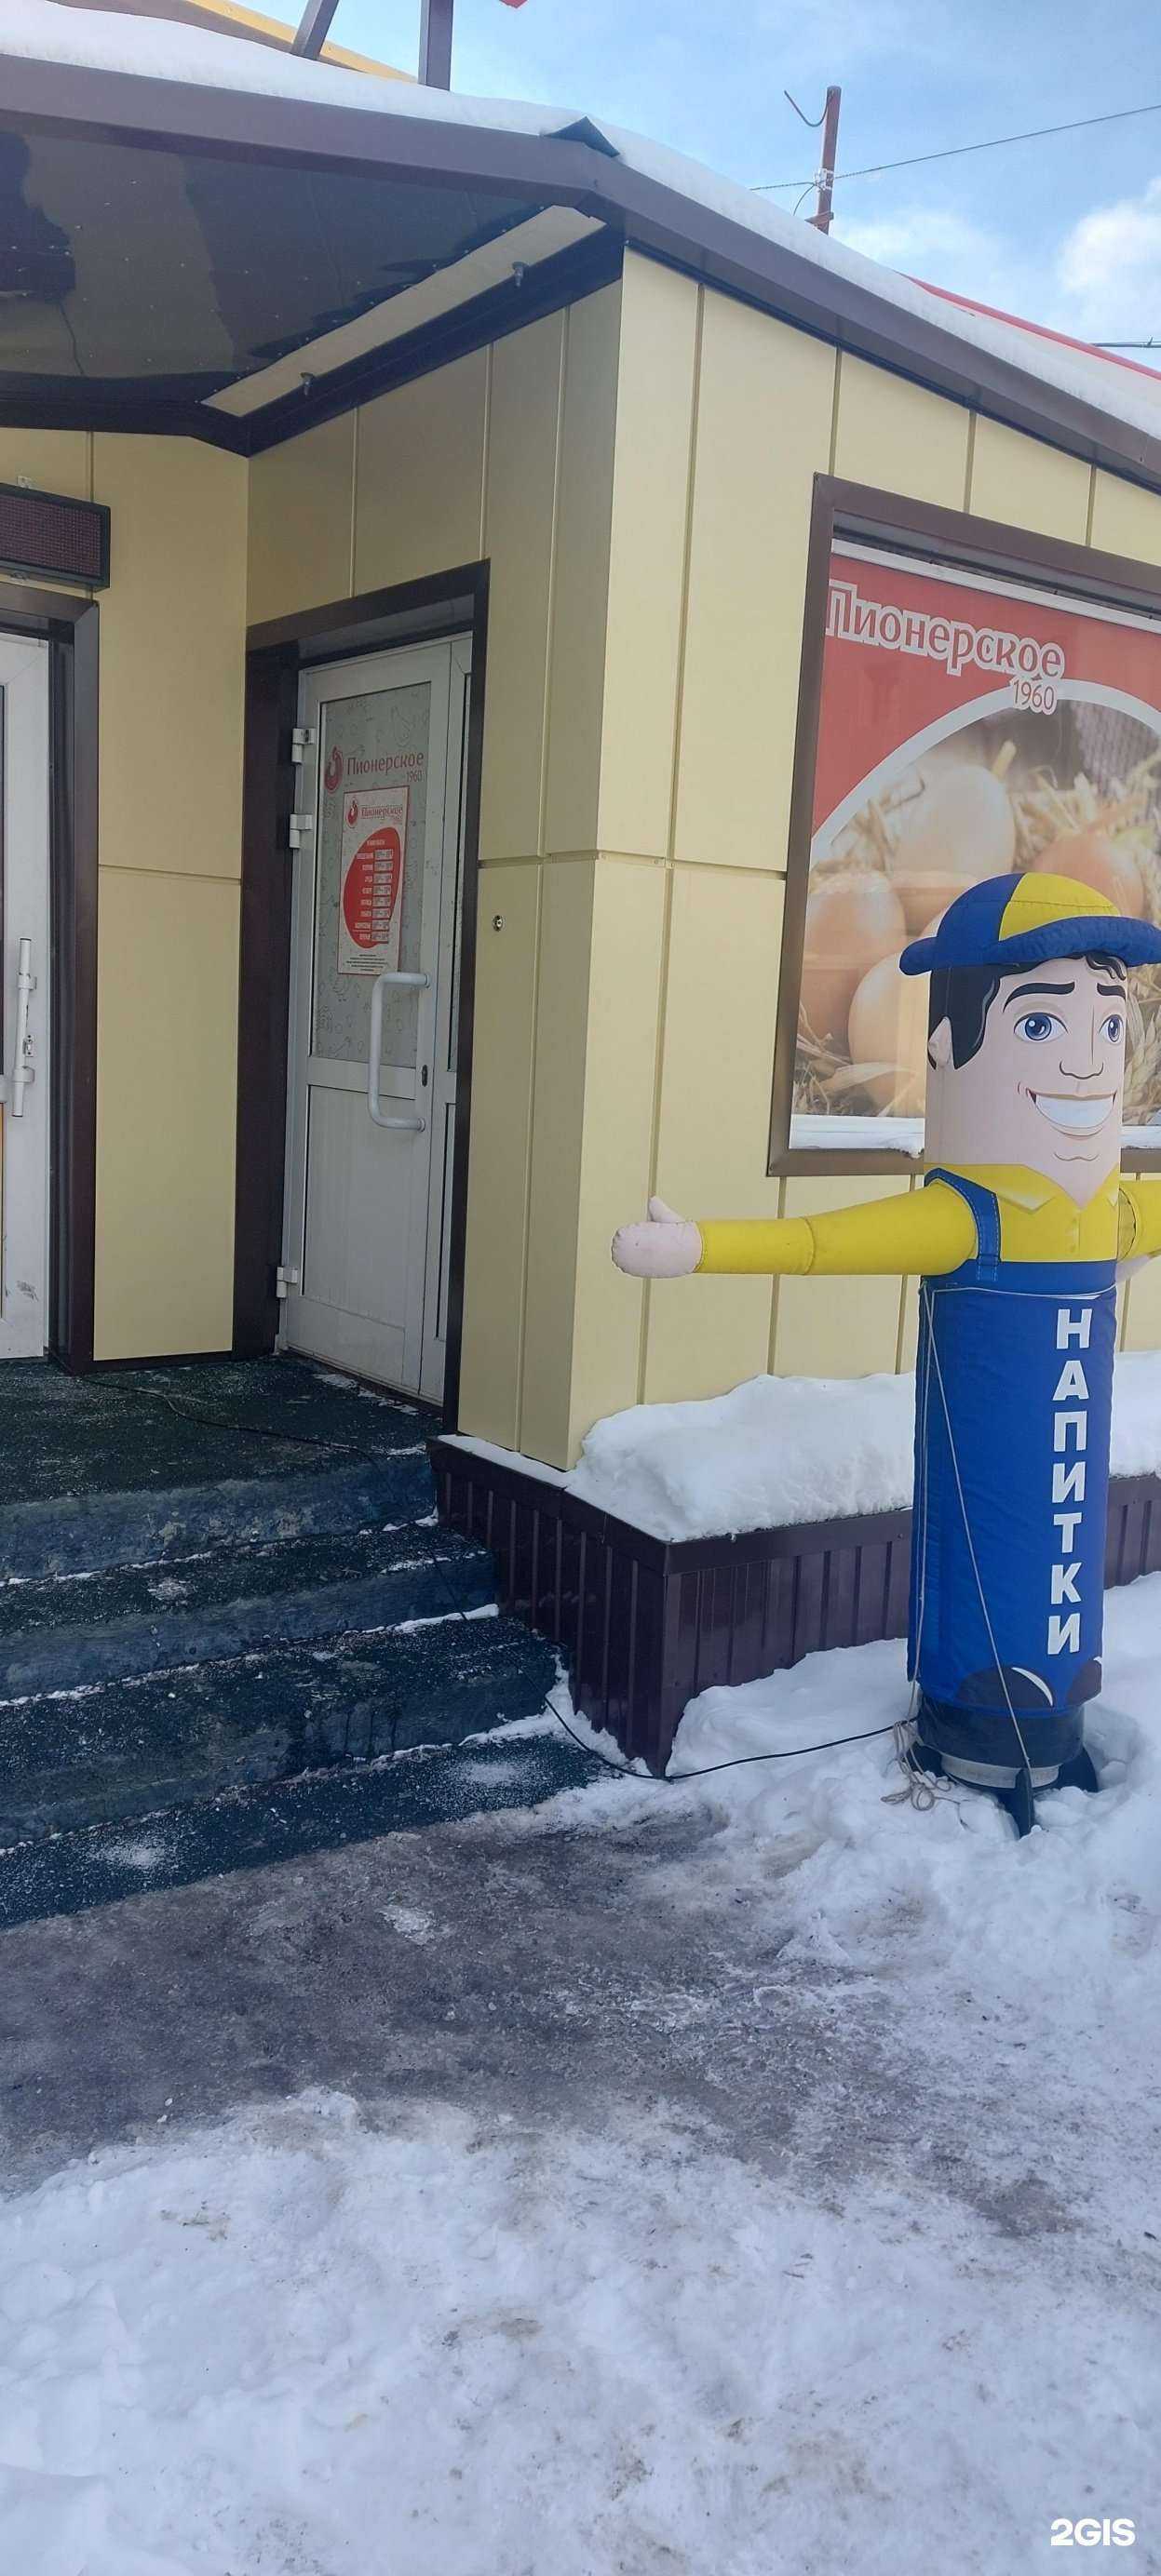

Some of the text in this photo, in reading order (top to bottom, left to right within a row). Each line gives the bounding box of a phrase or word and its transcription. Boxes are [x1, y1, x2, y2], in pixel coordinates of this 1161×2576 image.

[826, 584, 1063, 678] Пионерское
[1012, 678, 1055, 712] 1960
[347, 752, 425, 776] Пионерское
[406, 769, 423, 783] 1960
[1047, 1308, 1092, 1656] НАПИТКИ
